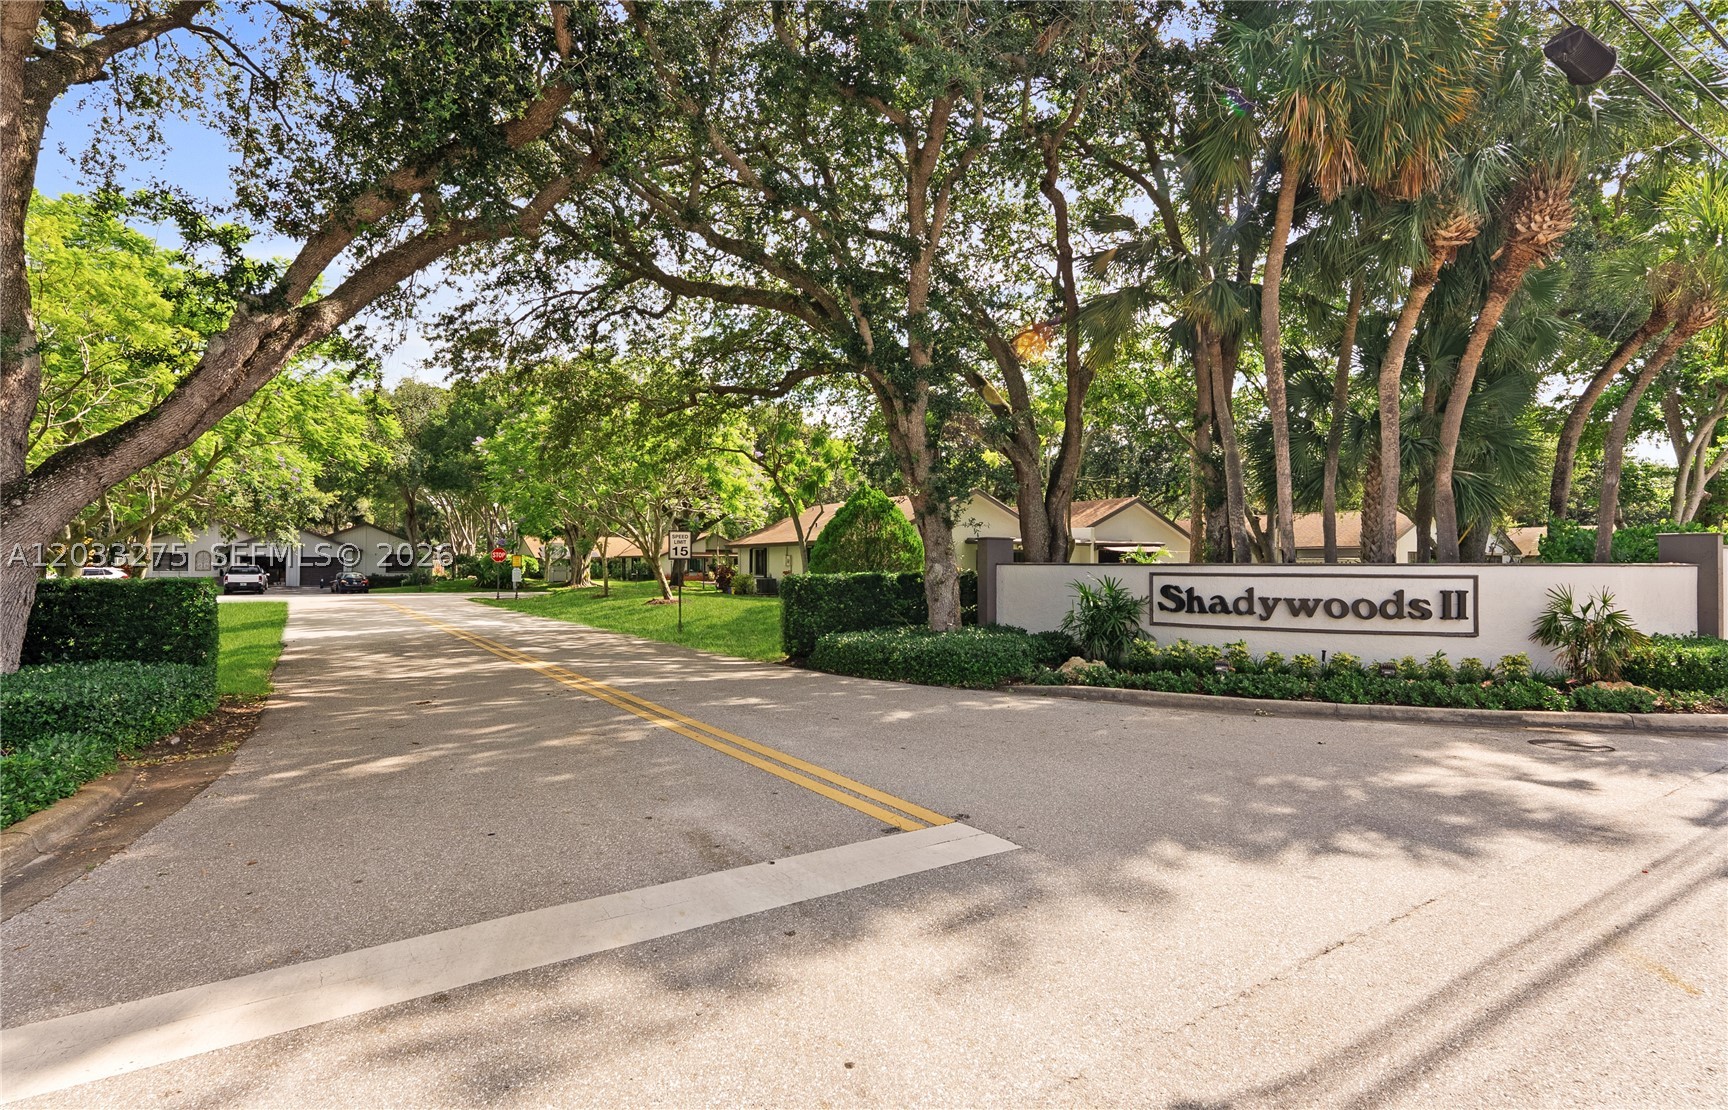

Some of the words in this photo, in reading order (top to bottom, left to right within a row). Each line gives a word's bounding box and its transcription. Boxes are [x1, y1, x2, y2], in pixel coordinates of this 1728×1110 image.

[492, 551, 506, 559] STOP
[672, 546, 689, 557] 15
[1157, 584, 1433, 622] Shadywoods
[1439, 589, 1469, 621] II
